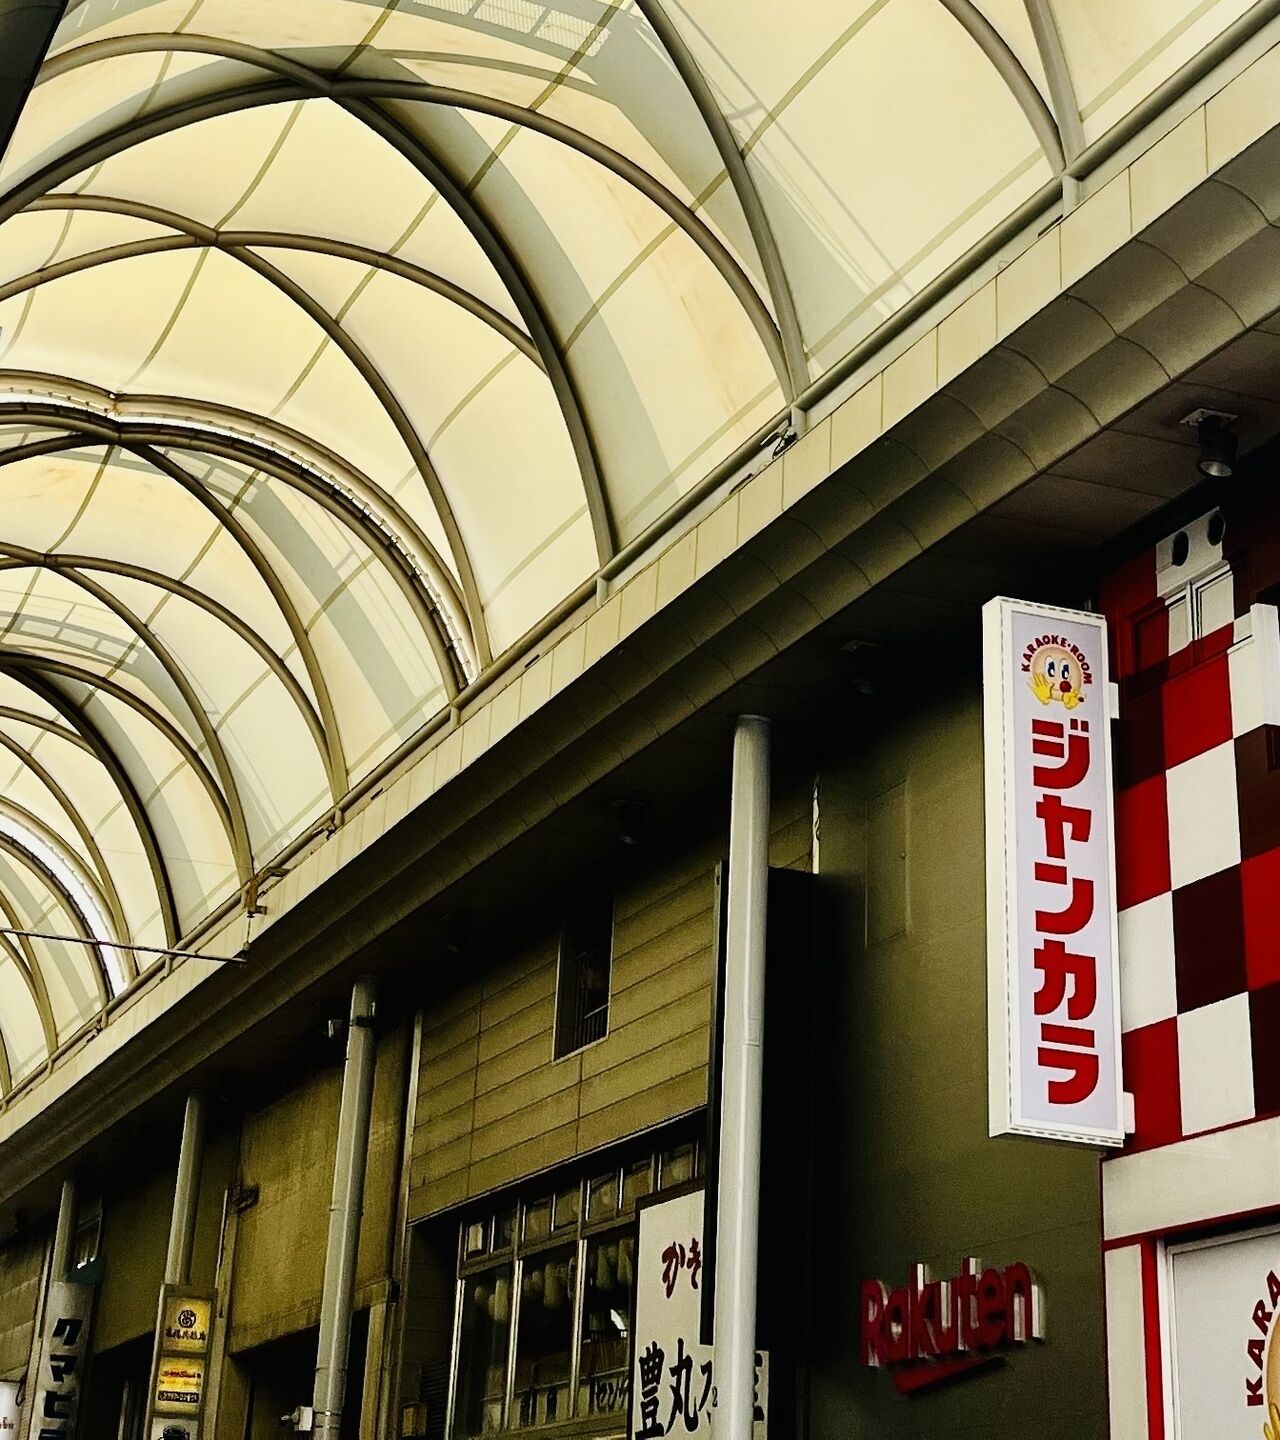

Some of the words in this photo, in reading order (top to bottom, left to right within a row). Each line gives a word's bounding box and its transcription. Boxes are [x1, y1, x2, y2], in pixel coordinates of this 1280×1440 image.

[1031, 717, 1101, 1107] ジャンカラ
[859, 1256, 1045, 1367] Rakuten
